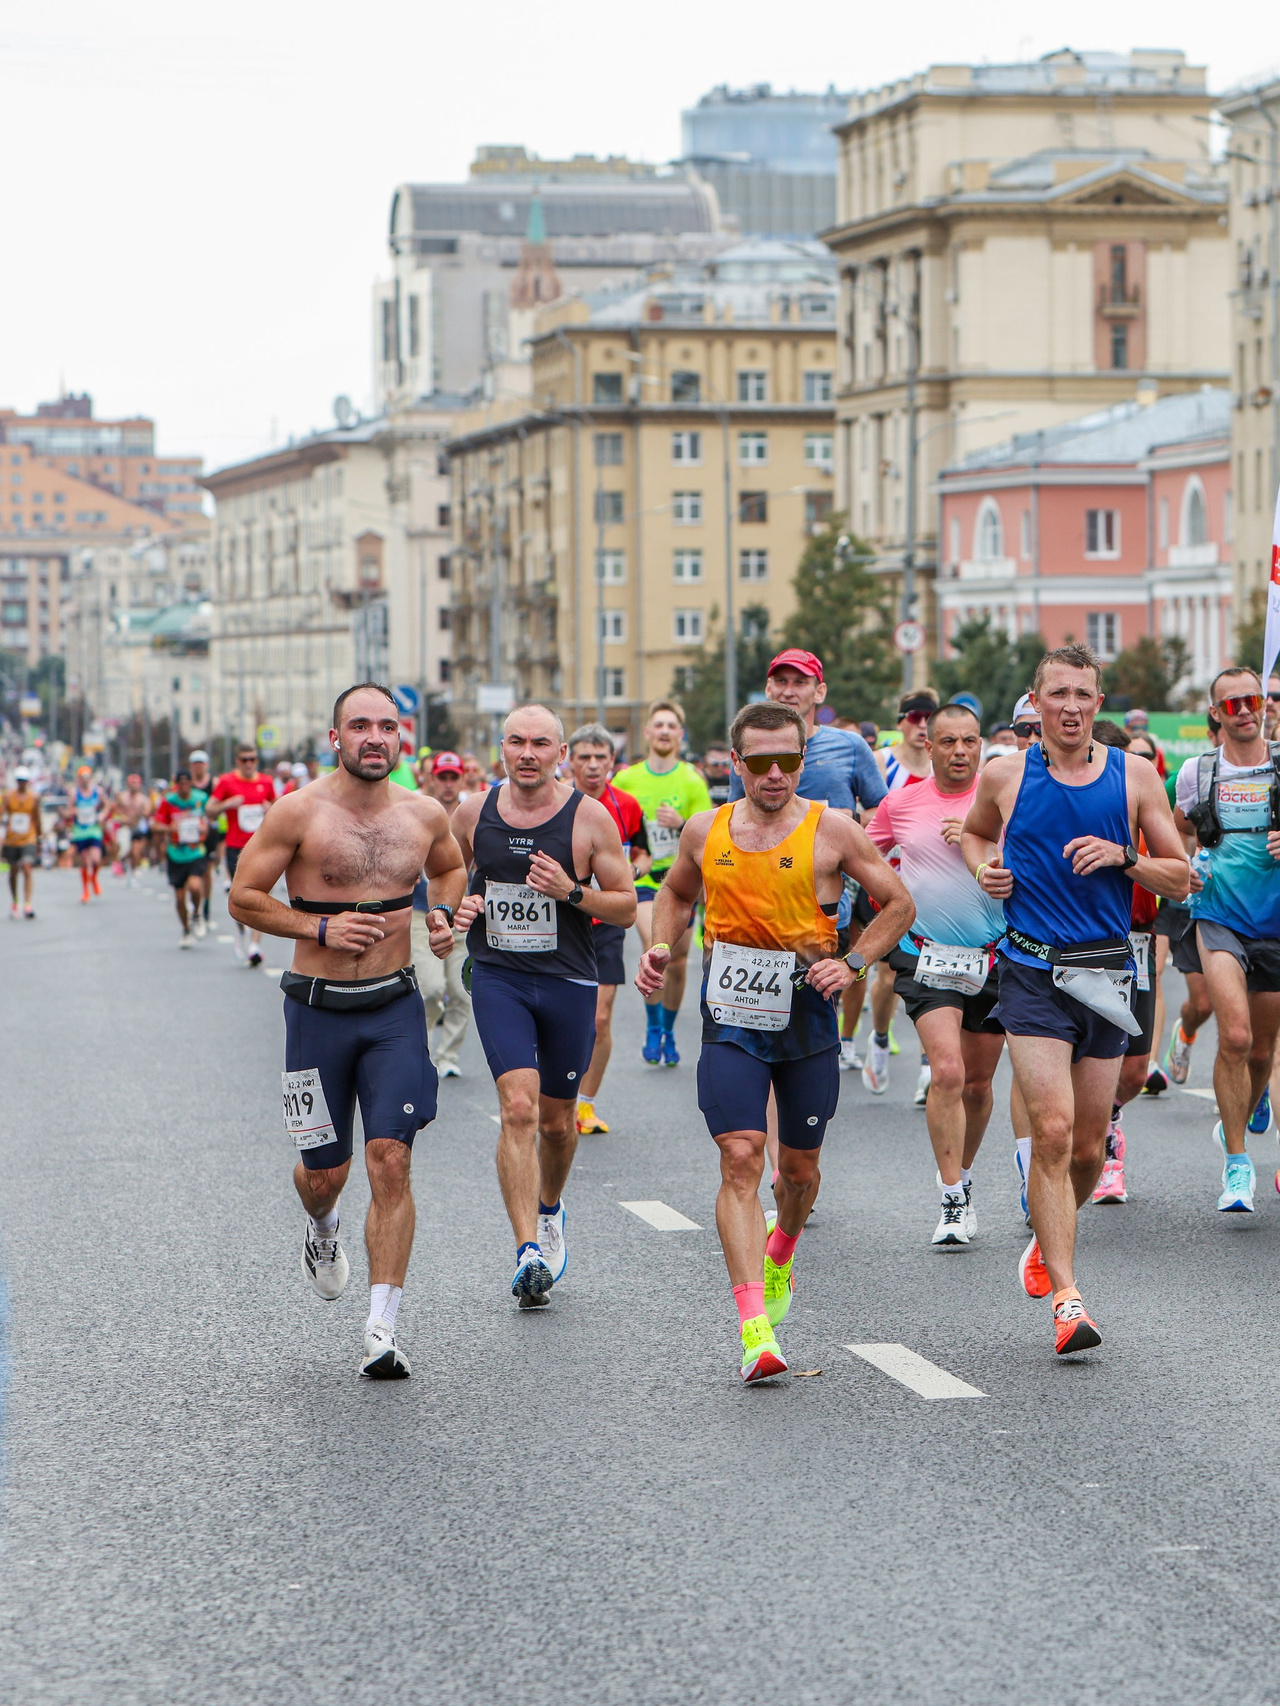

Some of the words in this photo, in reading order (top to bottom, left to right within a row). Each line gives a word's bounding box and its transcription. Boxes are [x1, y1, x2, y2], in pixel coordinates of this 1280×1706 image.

[1218, 783, 1272, 793] АРАФО
[518, 891, 535, 900] 42,2
[487, 899, 552, 922] 19861
[507, 924, 531, 932] MARAT
[492, 935, 499, 946] D
[751, 958, 771, 968] 42,2
[773, 960, 789, 969] КМ
[718, 965, 782, 997] 6244
[734, 995, 760, 1006] АНТОН
[713, 1007, 722, 1021] C
